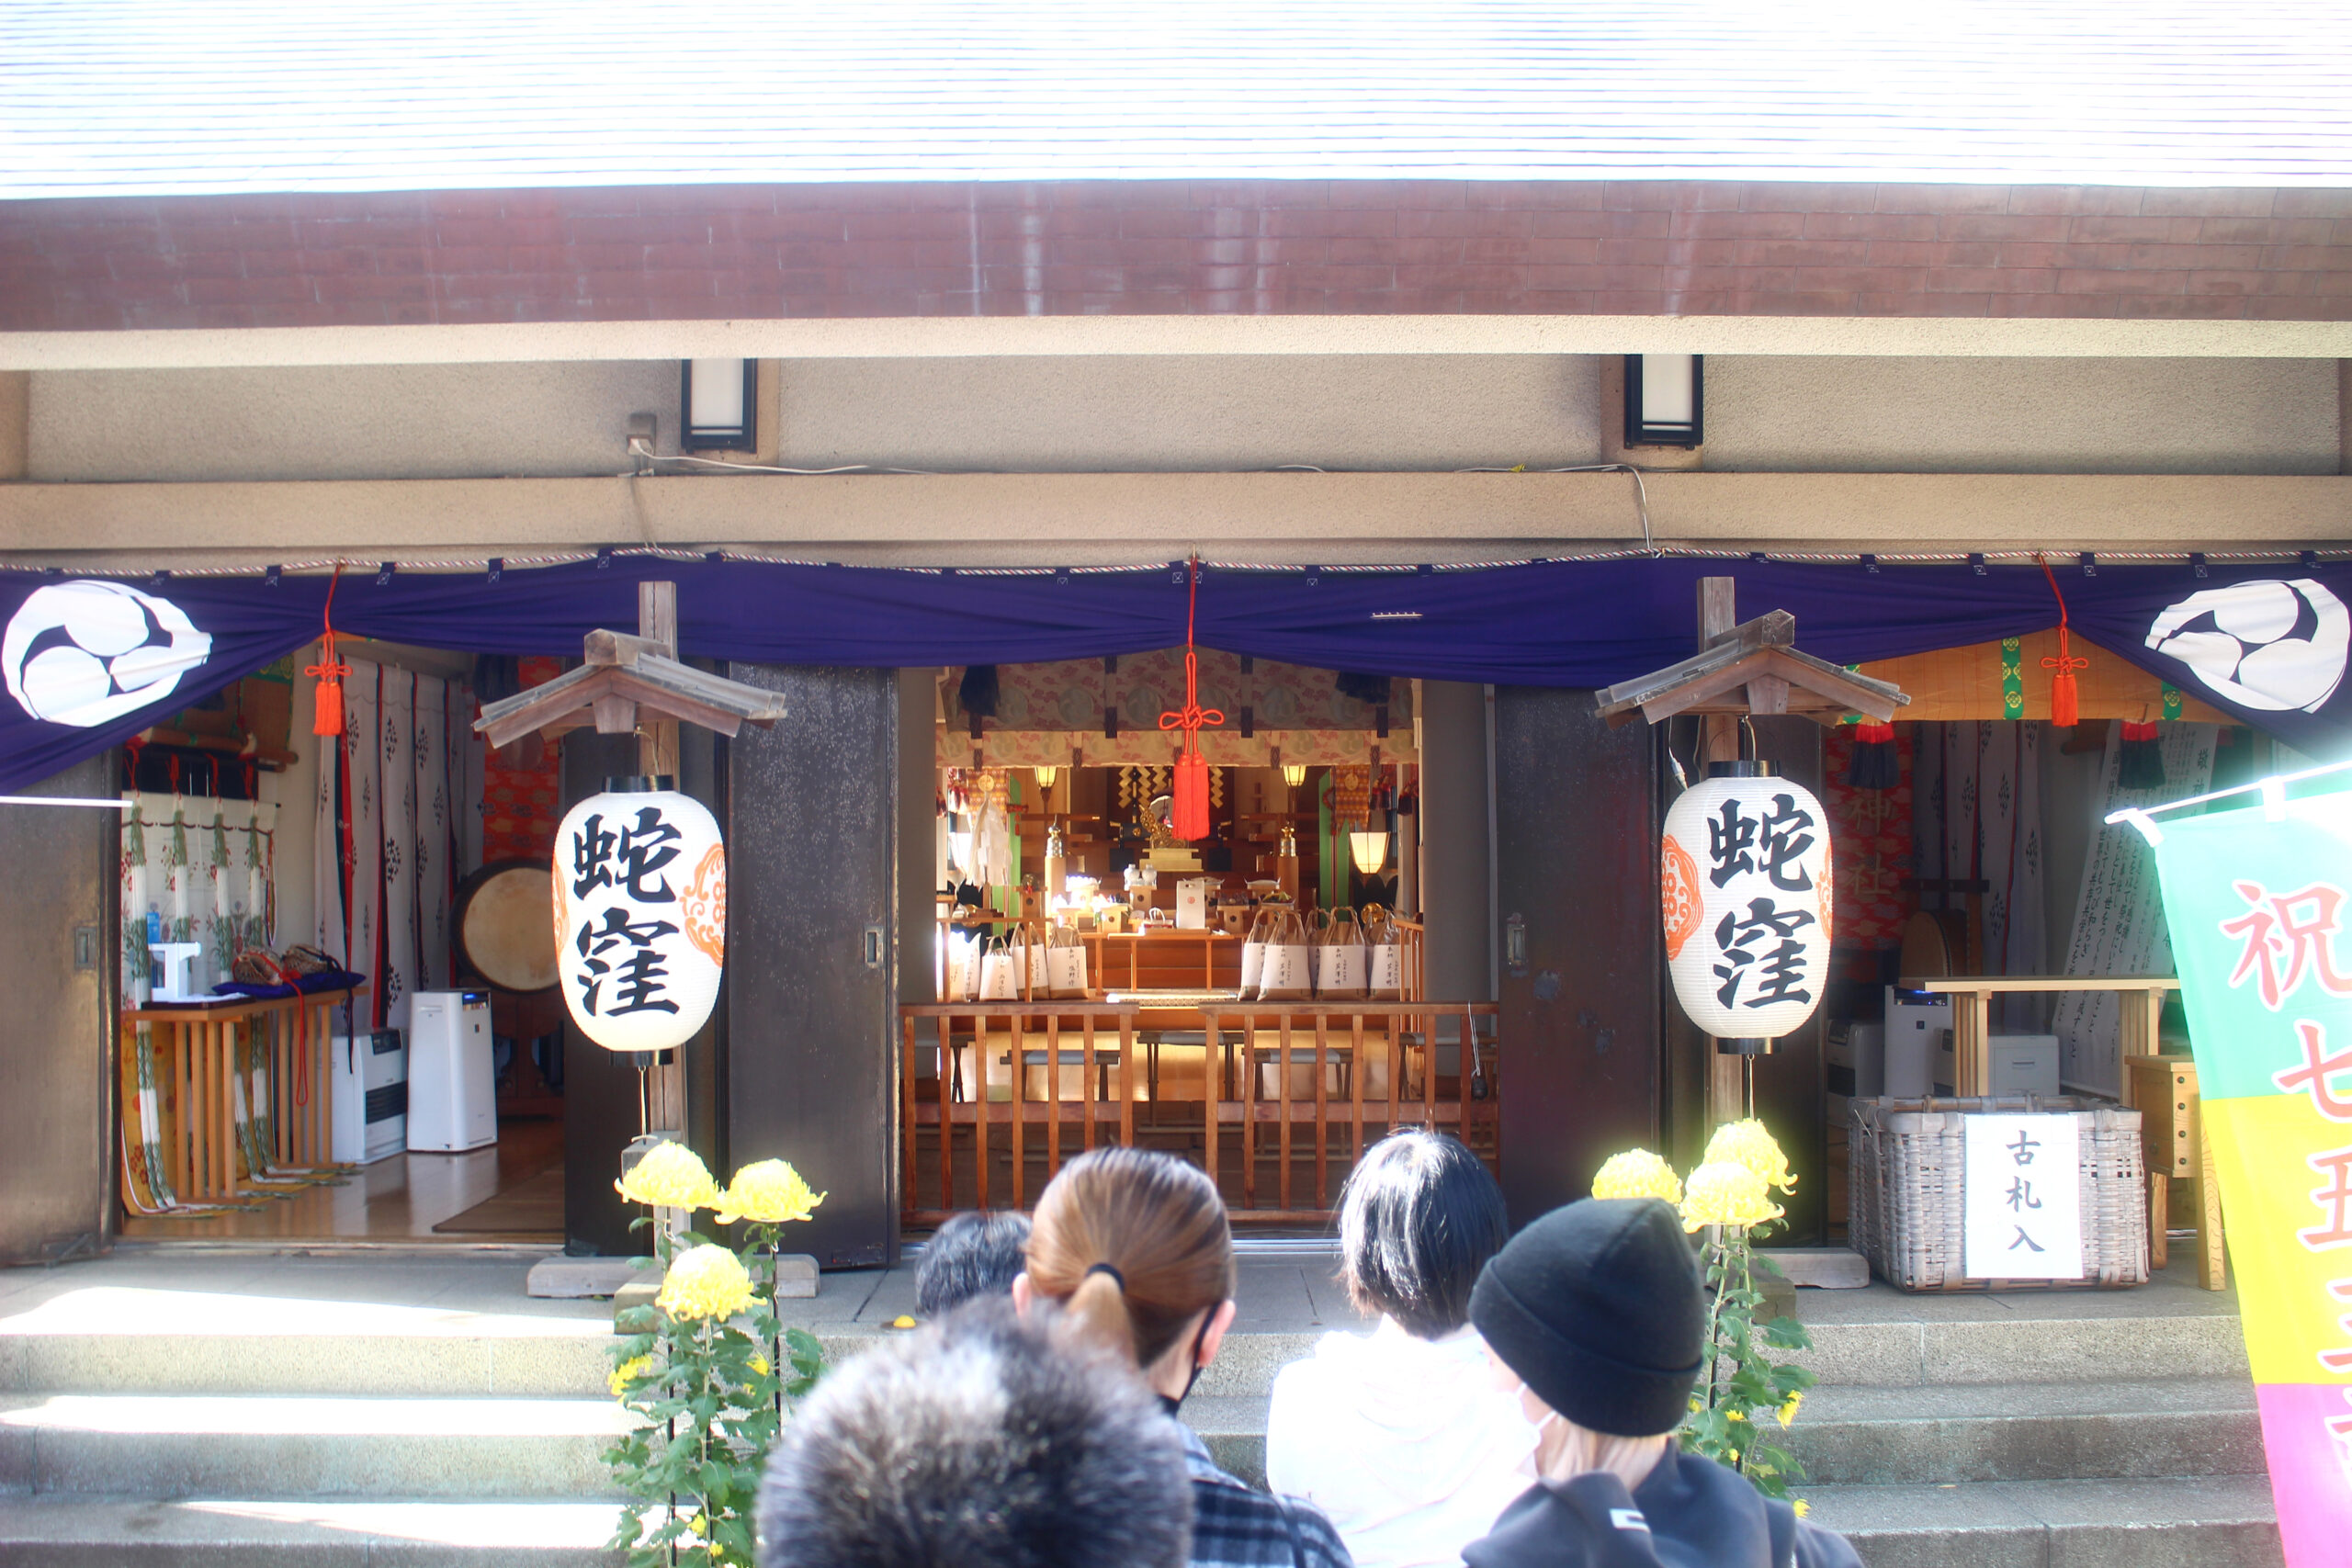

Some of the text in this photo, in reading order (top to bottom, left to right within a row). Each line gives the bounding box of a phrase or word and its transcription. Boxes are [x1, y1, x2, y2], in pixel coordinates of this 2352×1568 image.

[573, 807, 682, 1017] 蛇窪
[1707, 794, 1815, 1010] 蛇窪
[2005, 1130, 2045, 1252] 古札入
